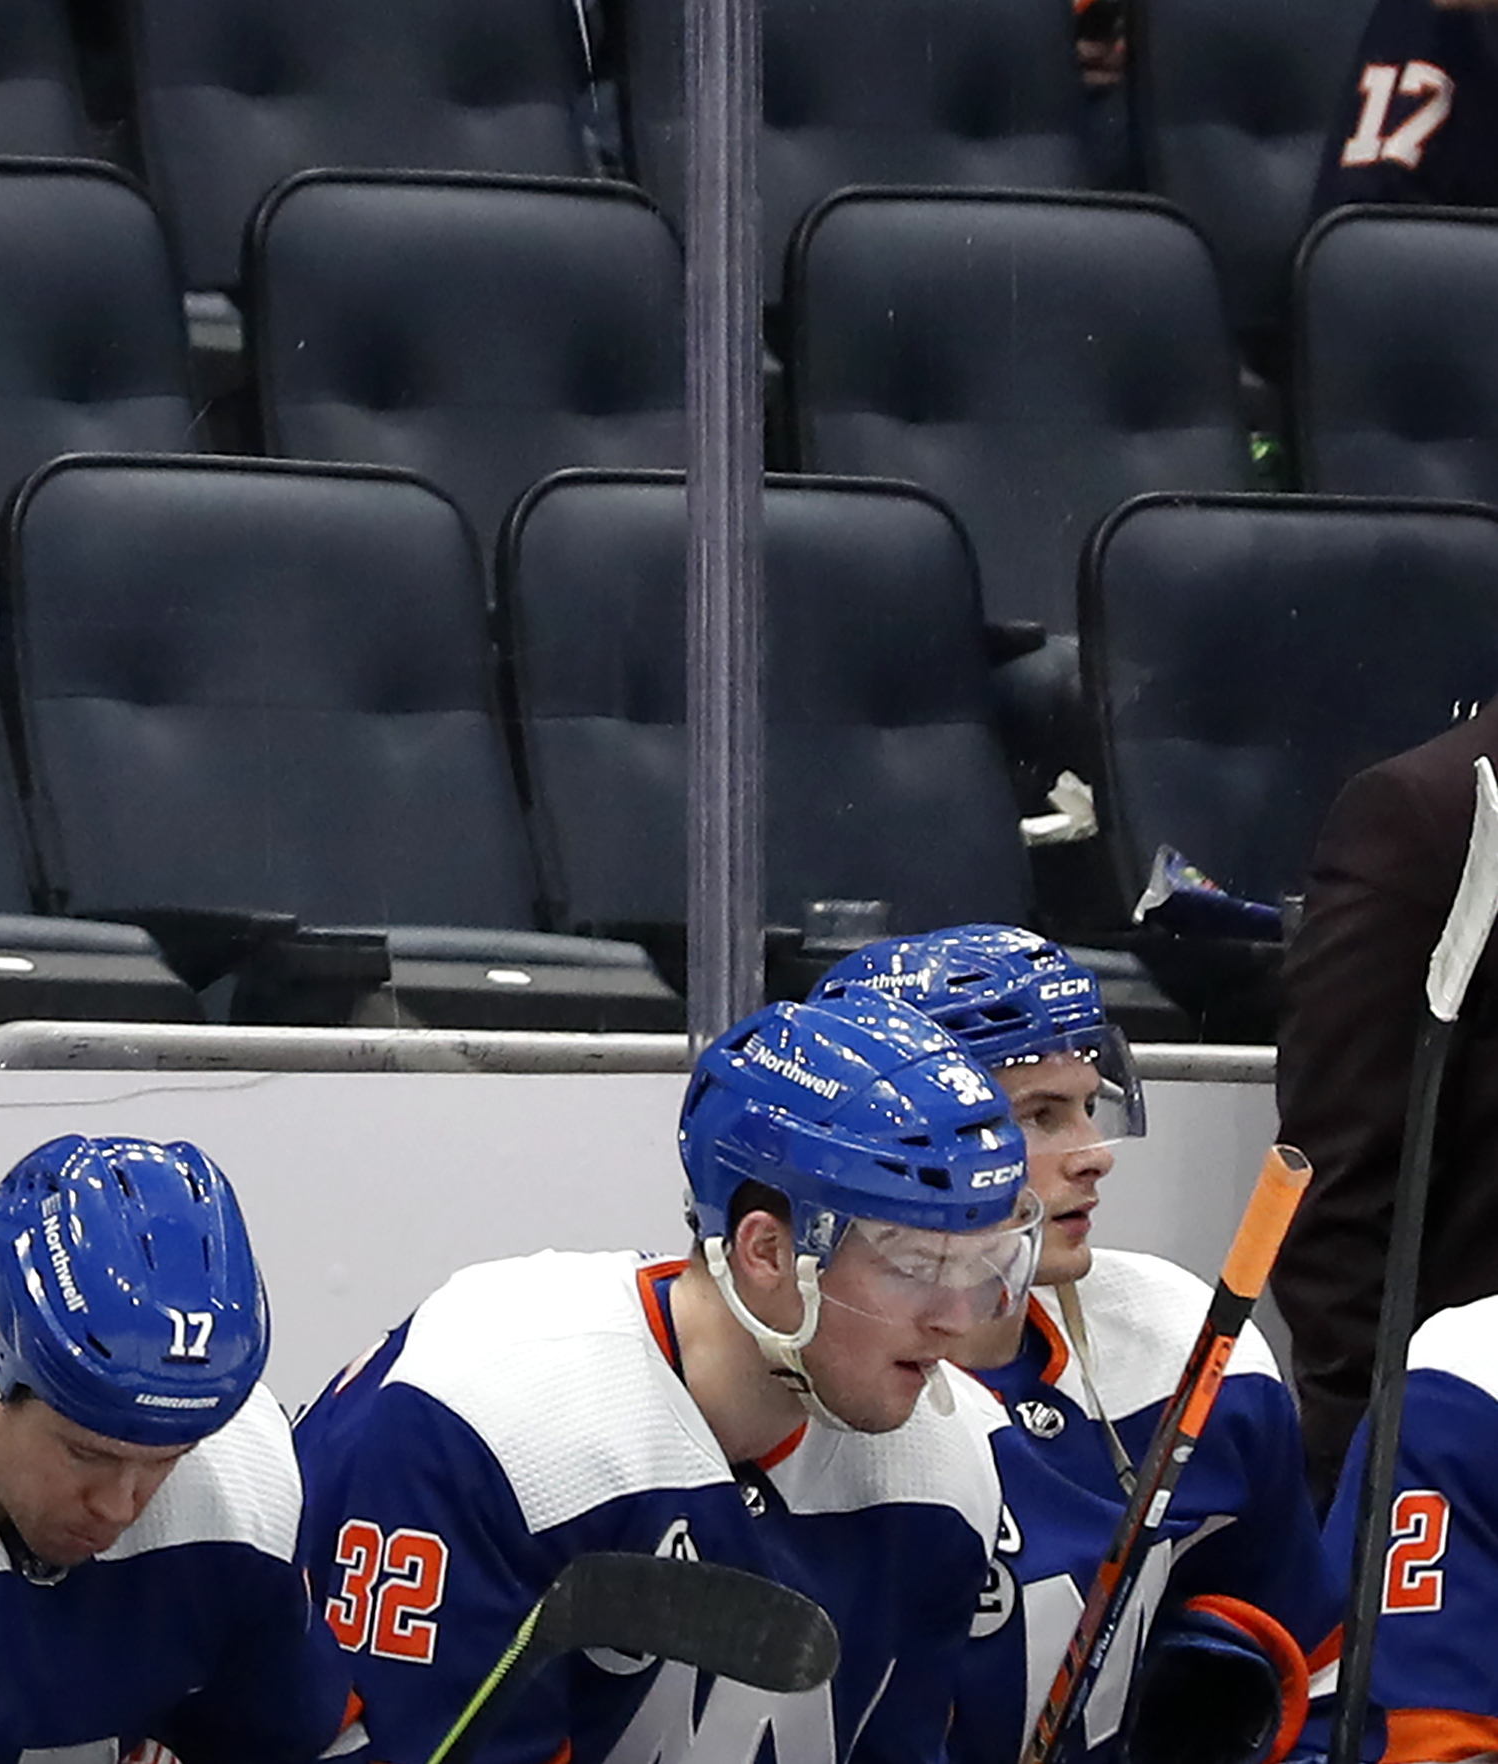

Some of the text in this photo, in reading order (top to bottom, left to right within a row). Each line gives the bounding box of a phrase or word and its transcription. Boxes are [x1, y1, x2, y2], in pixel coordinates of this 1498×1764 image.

[1340, 59, 1455, 170] 17
[1040, 978, 1090, 1000] CCM
[752, 1046, 841, 1100] Northwell
[970, 1161, 1024, 1188] CCM
[43, 1214, 86, 1312] Northwell
[164, 1307, 214, 1357] 17
[1381, 1490, 1450, 1614] 2
[324, 1518, 450, 1665] 32
